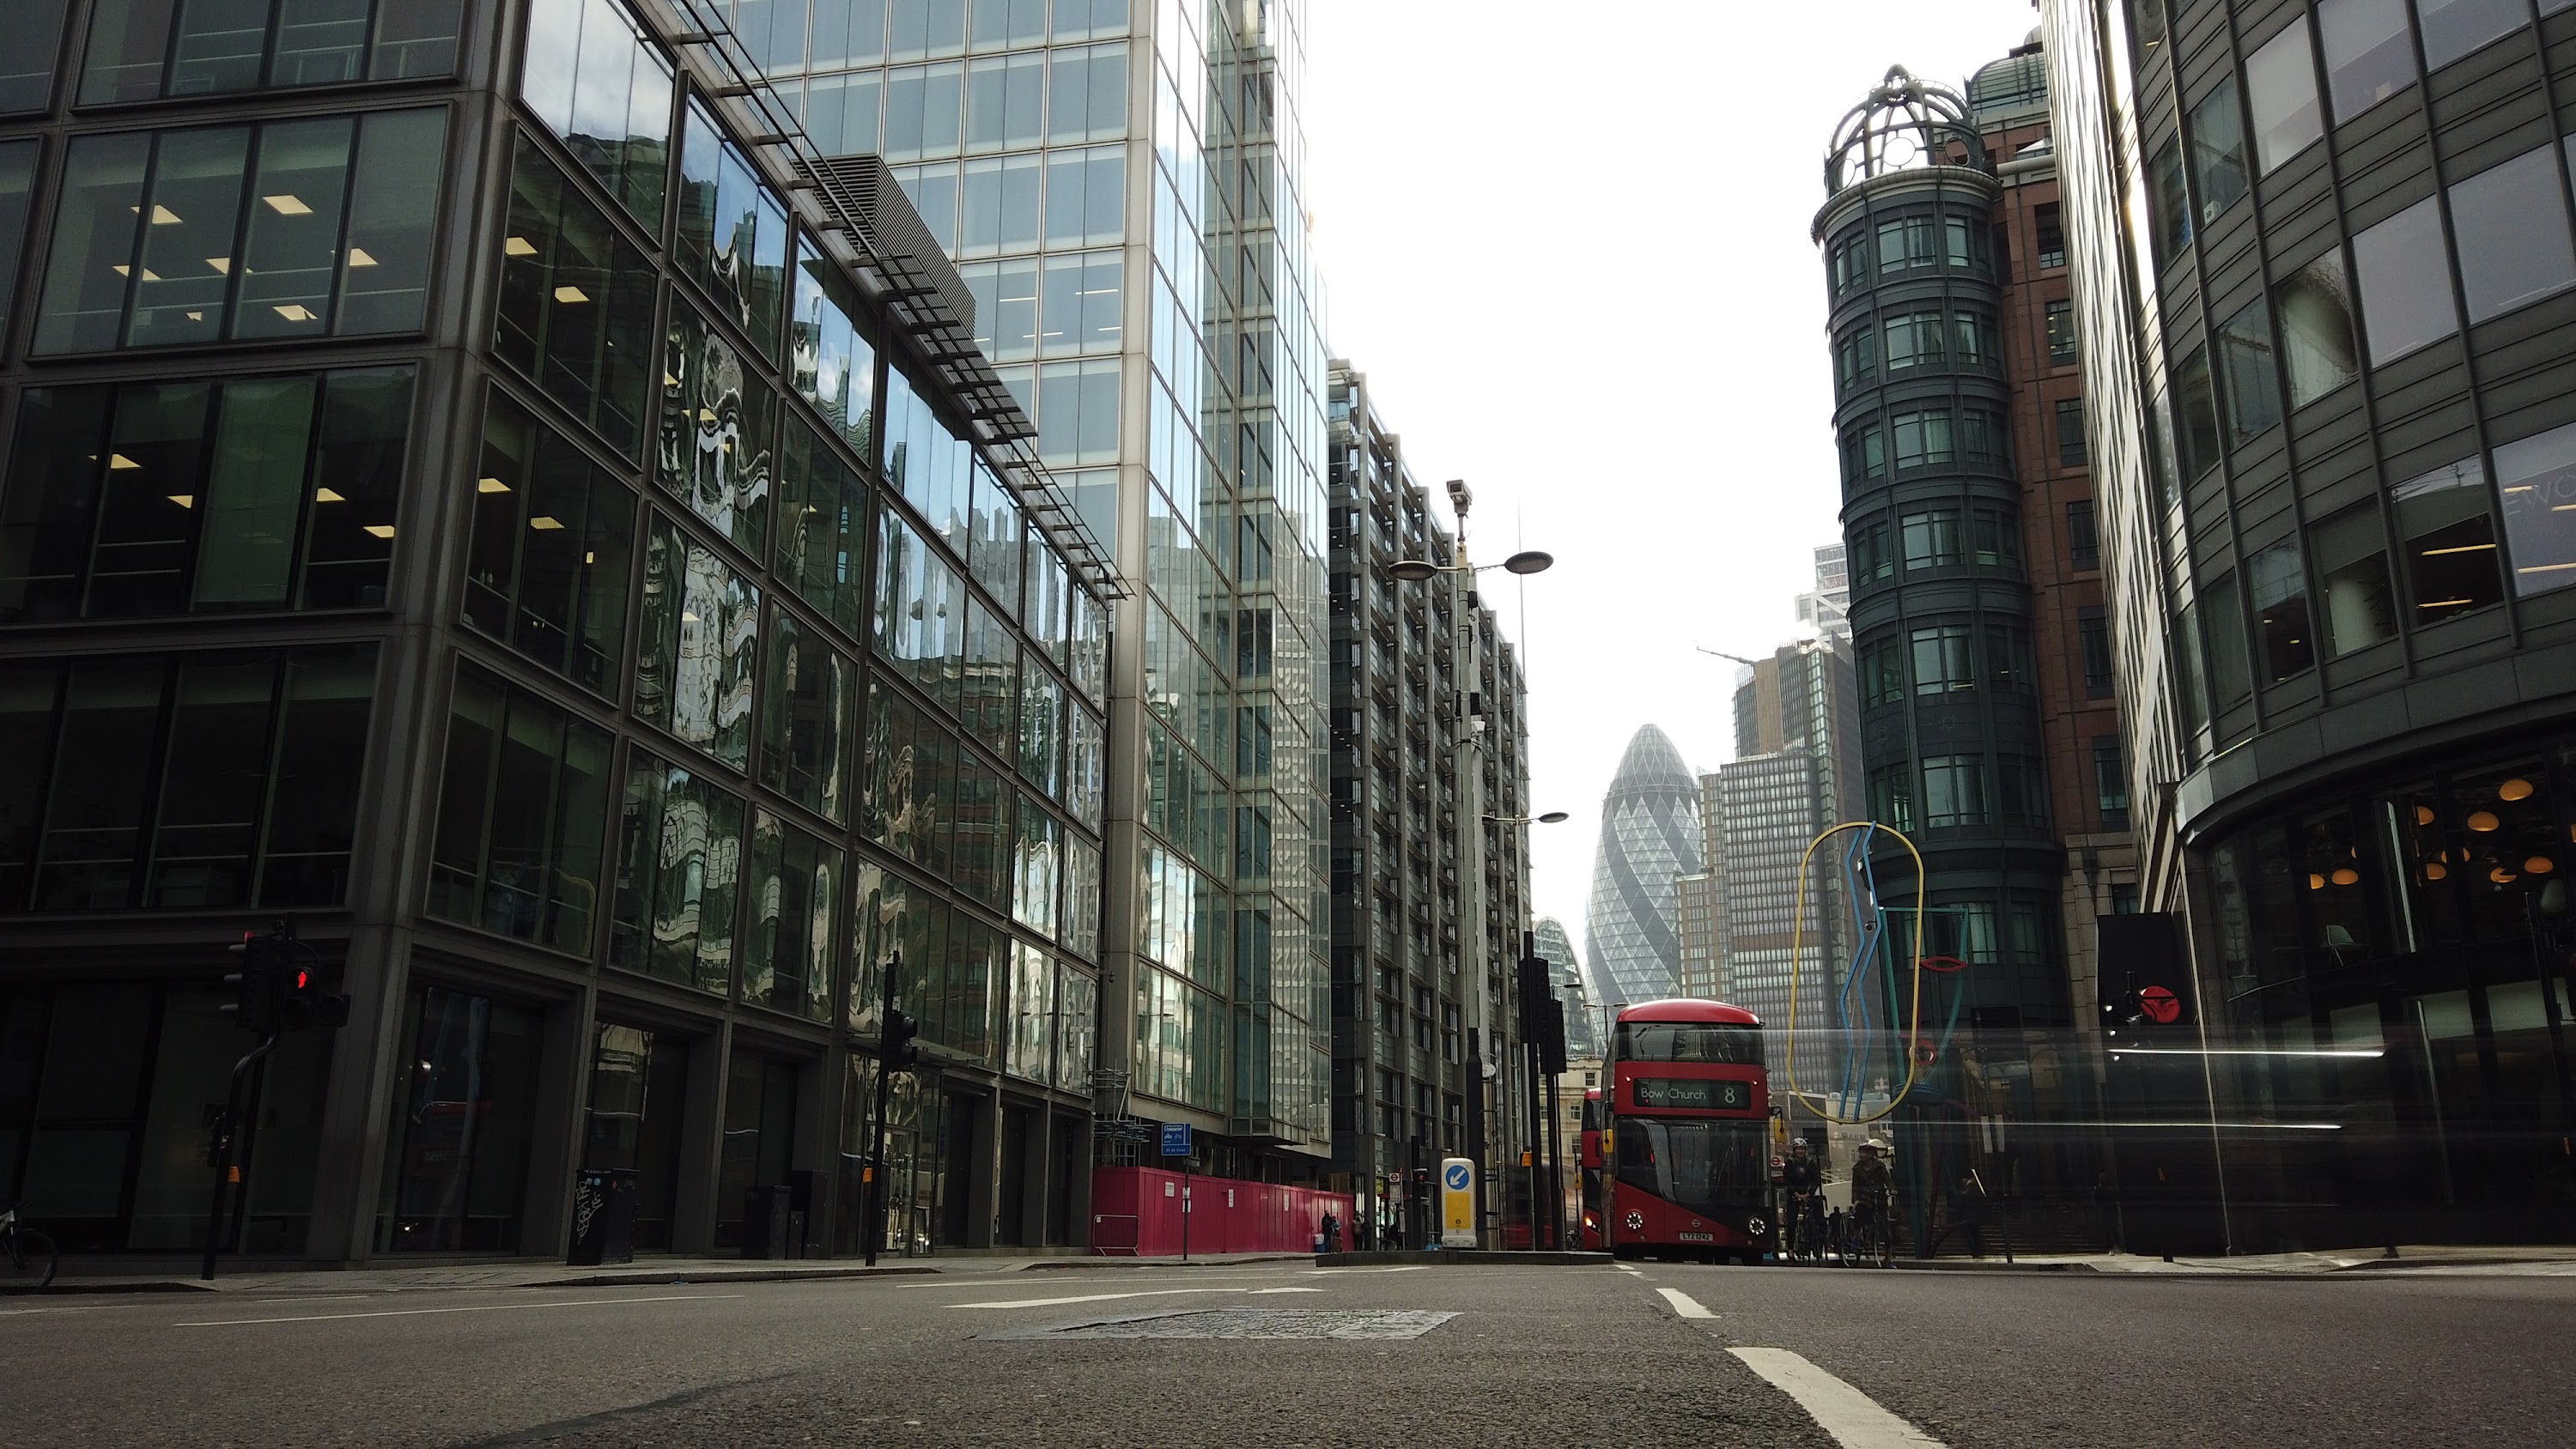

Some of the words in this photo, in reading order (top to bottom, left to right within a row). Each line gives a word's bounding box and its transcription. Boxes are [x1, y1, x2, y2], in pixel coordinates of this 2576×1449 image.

[1641, 1087, 1664, 1099] Bow
[1668, 1088, 1706, 1100] Church
[1724, 1087, 1735, 1104] 8
